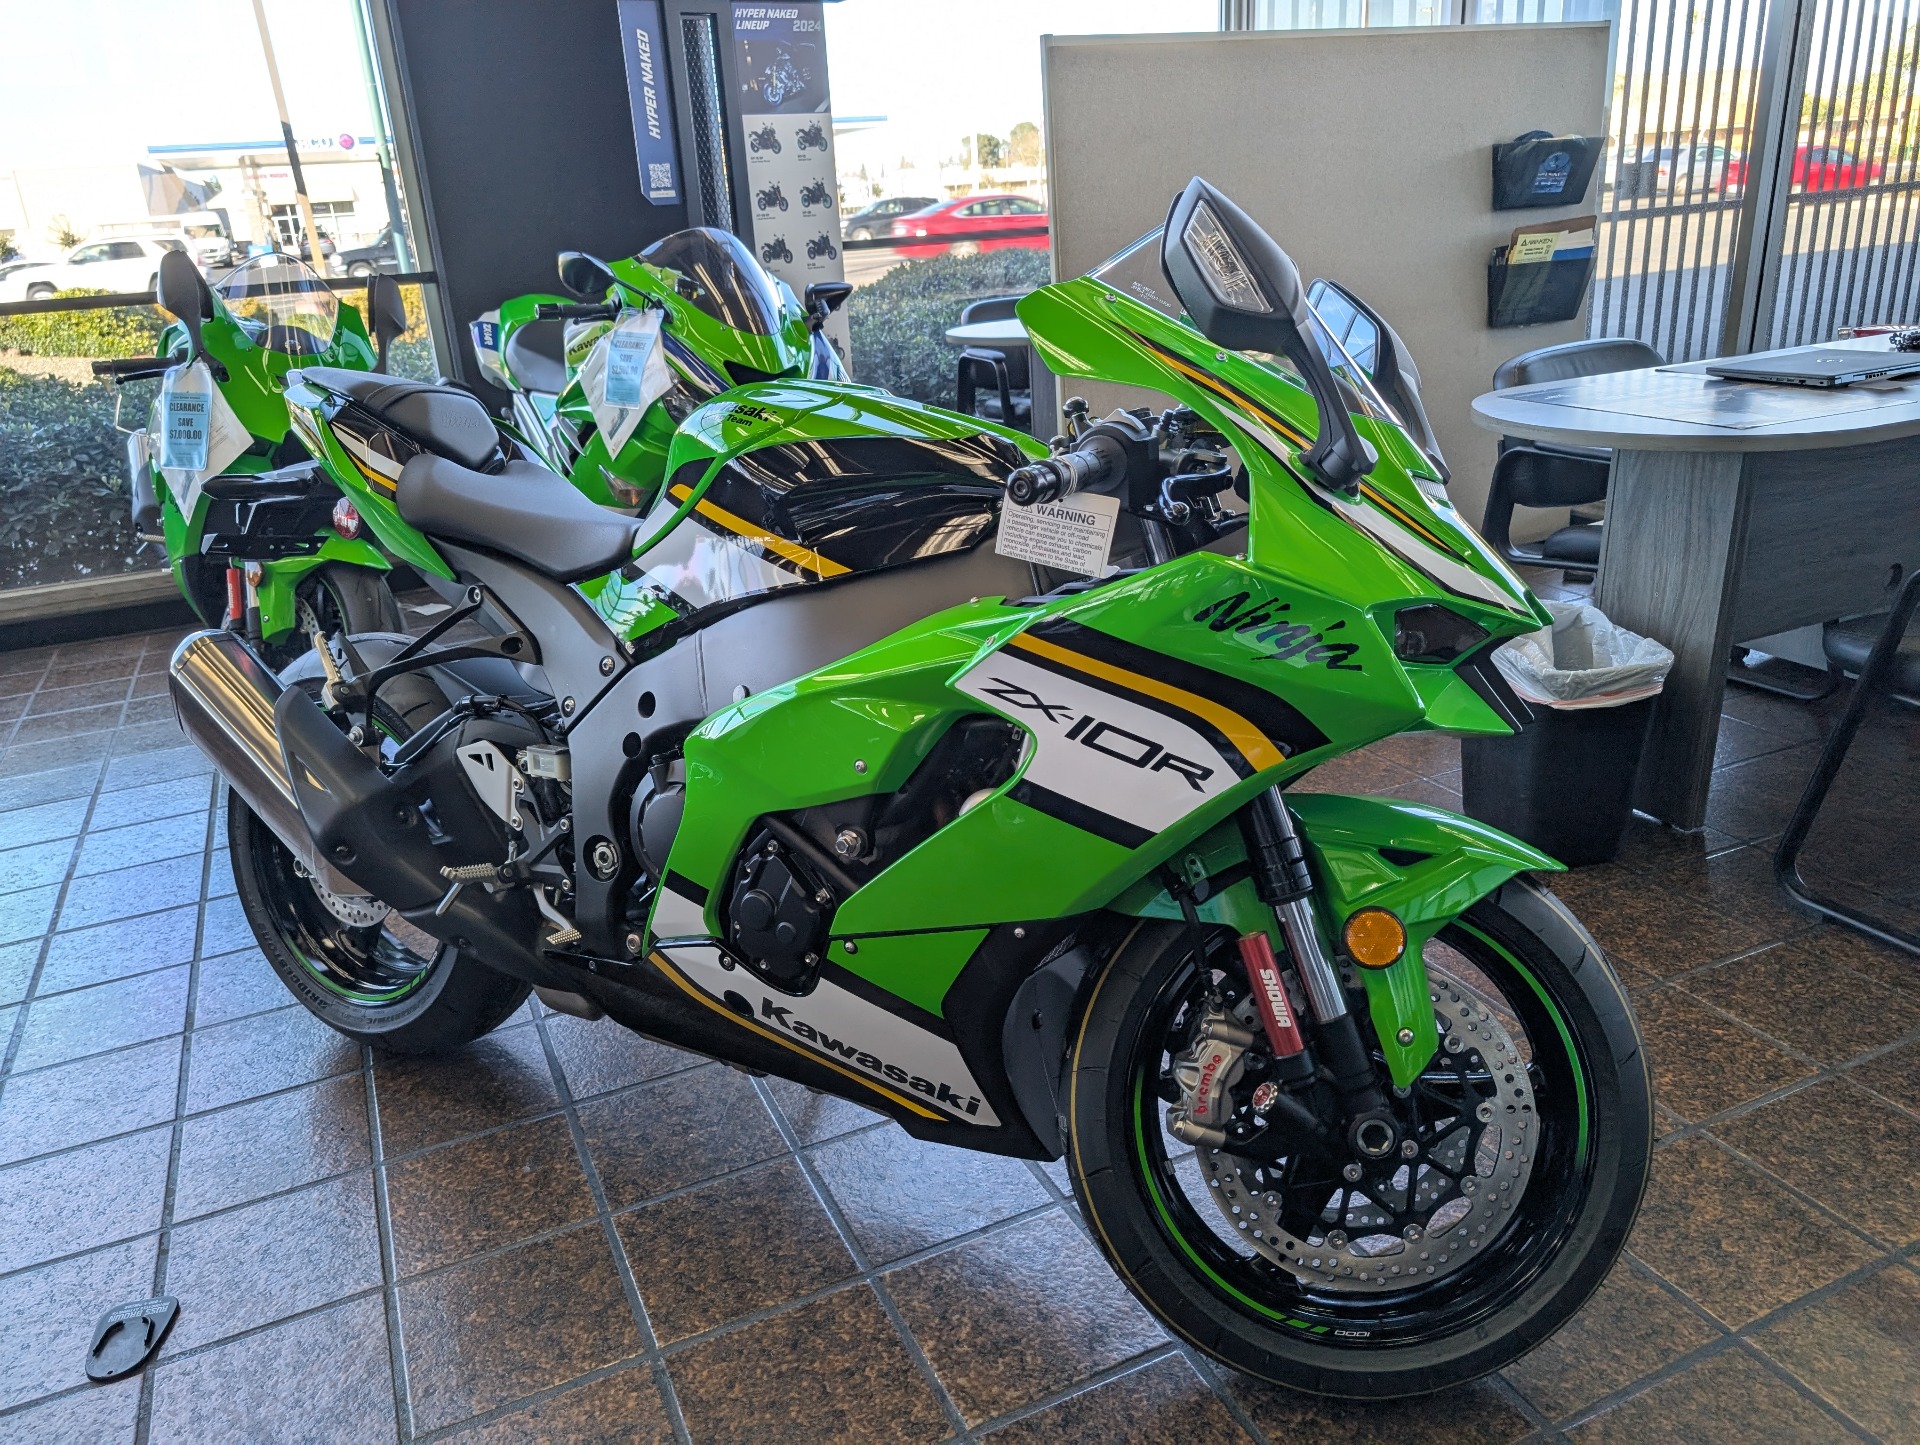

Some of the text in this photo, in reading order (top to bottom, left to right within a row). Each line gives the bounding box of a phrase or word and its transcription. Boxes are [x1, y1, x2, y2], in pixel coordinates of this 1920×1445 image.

[735, 8, 798, 18] HYPER NAKED
[736, 20, 769, 30] LINEUP
[793, 20, 821, 31] 2024
[636, 28, 661, 140] HYPER NAKED
[615, 340, 647, 350] CLEARANCE
[619, 354, 634, 363] SAVE
[169, 402, 204, 412] CLEARANCE
[178, 418, 194, 427] SAVE
[726, 414, 753, 427] Team
[1037, 505, 1095, 525] WARNING
[1006, 525, 1024, 534] vehicle
[1037, 533, 1056, 542] expose
[1075, 541, 1103, 551] chemicals
[1012, 520, 1039, 530] passenger
[1040, 526, 1059, 534] vehicle
[1068, 532, 1089, 541] off-road
[1062, 523, 1072, 531] and
[1074, 526, 1106, 539] maintaining
[1003, 543, 1018, 551] which
[1030, 550, 1047, 558] known
[1055, 554, 1063, 562] the
[1064, 557, 1078, 566] State
[1029, 538, 1048, 547] engine
[1073, 547, 1091, 555] carbon
[1035, 557, 1051, 566] cause
[1052, 561, 1070, 570] cancer
[1083, 568, 1094, 576] birth
[1193, 591, 1362, 671] Ninja
[978, 676, 1215, 794] ZX-10R
[258, 922, 329, 1010] BRIDGESTONE
[1259, 968, 1292, 1028] SHOWA
[761, 996, 981, 1117] Kawasaki
[1194, 1054, 1222, 1116] brembo
[108, 1310, 144, 1322] BROWN
[144, 1305, 168, 1315] RUSS
